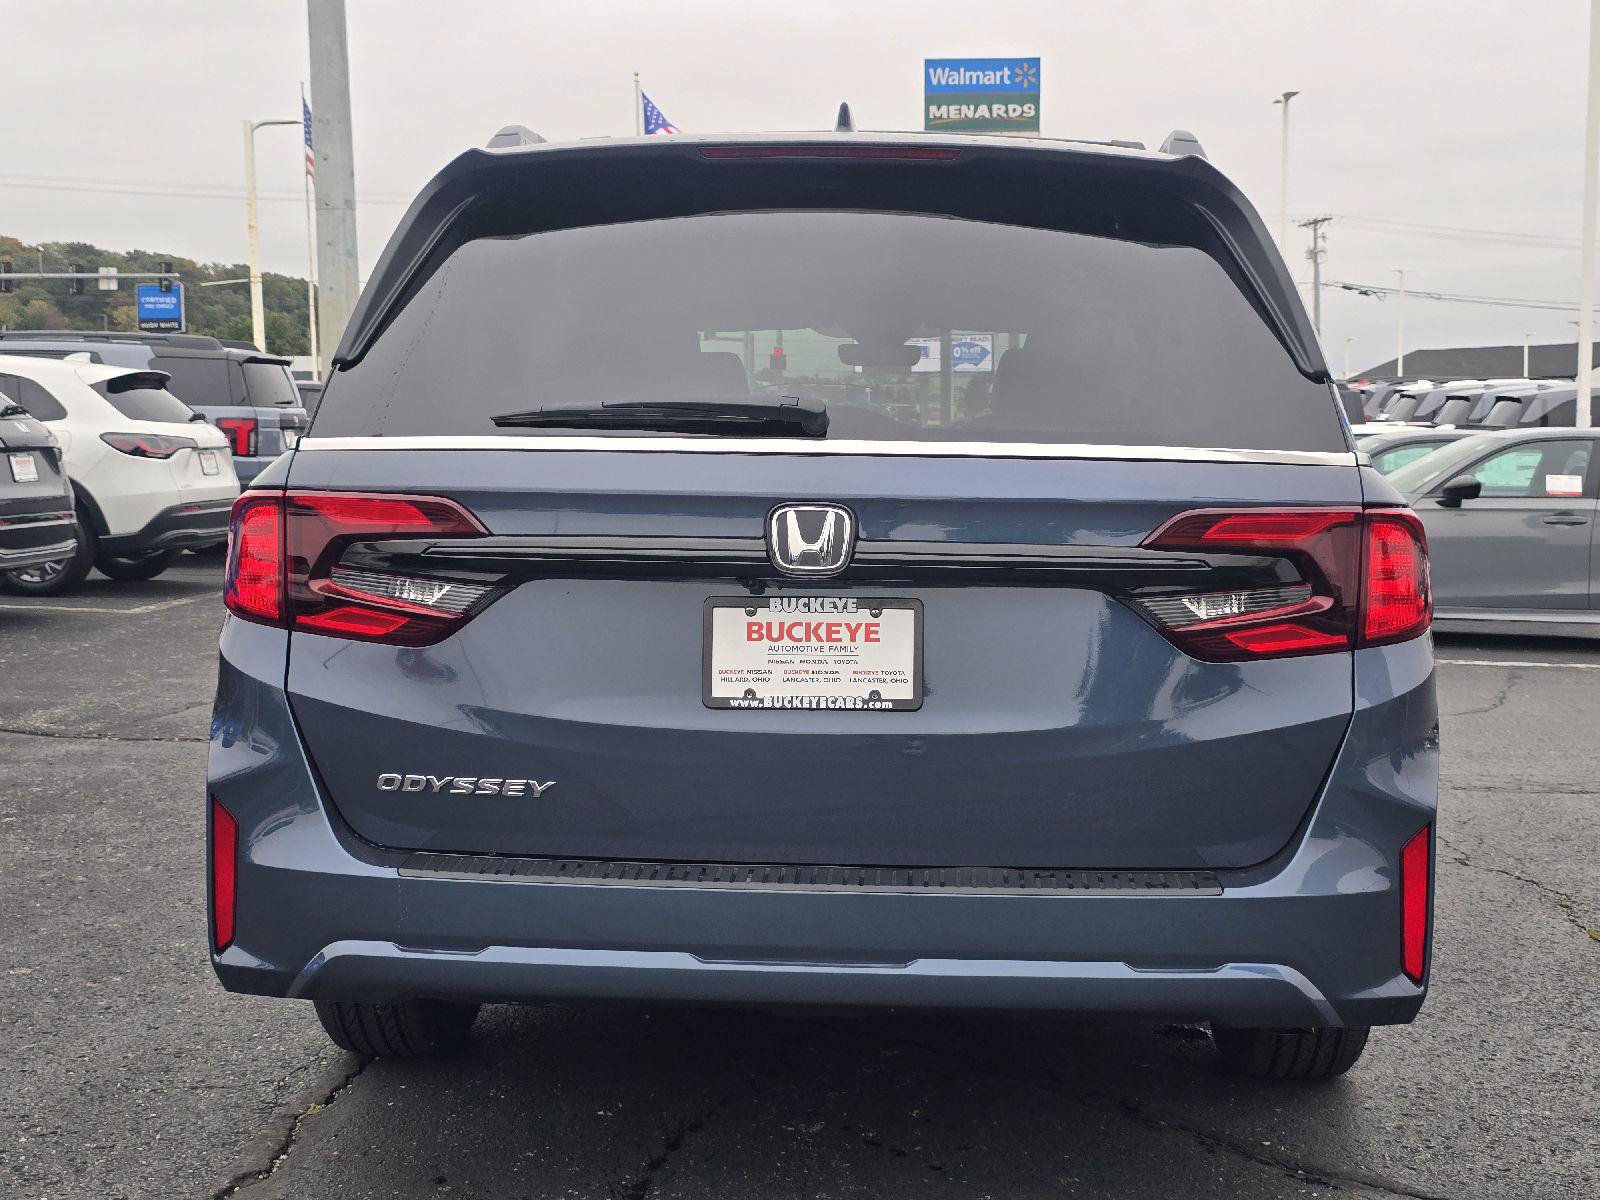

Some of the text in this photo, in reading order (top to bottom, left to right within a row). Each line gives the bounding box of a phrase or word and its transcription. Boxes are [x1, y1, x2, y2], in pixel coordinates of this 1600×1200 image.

[929, 67, 1010, 85] Walmart
[929, 104, 1036, 118] MENARDS
[769, 597, 858, 613] BUCKEYE
[746, 621, 881, 643] BUCKEYE
[768, 645, 859, 653] AUTOMOTIVE FAMILY
[729, 695, 893, 709] www.BUCKEYECARS.com
[376, 773, 557, 798] ODYSSEY
